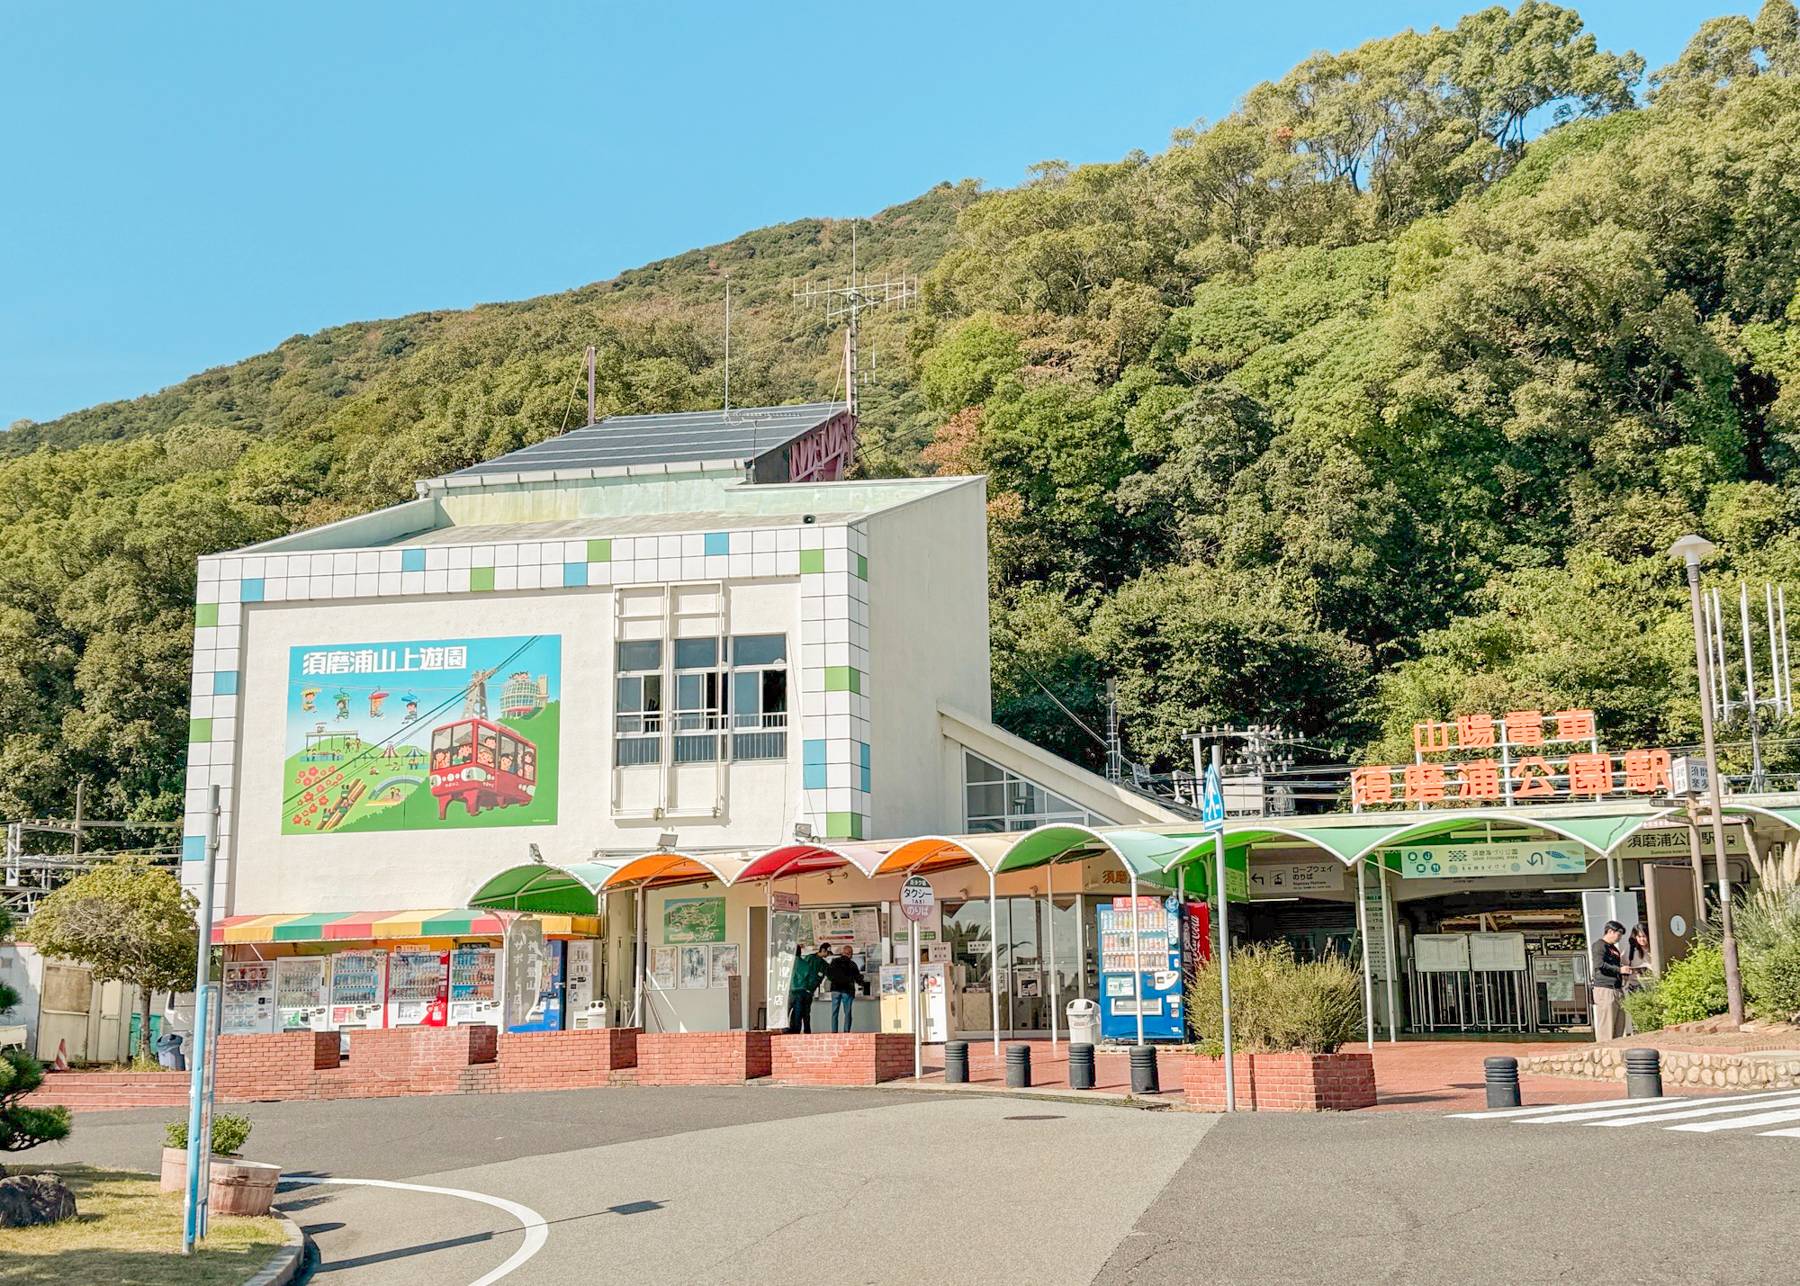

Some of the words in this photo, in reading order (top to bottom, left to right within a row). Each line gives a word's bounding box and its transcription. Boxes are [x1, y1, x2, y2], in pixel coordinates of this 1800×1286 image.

[302, 646, 467, 676] 須磨浦山上遊園
[1414, 708, 1595, 752] 山陽電車
[1351, 749, 1673, 805] 須磨浦公園駅
[1627, 831, 1715, 849] 須磨浦公駅
[1102, 870, 1131, 884] 須磨
[1292, 865, 1334, 873] ロープウェイ
[904, 888, 932, 898] タクシー
[907, 906, 928, 916] のりば
